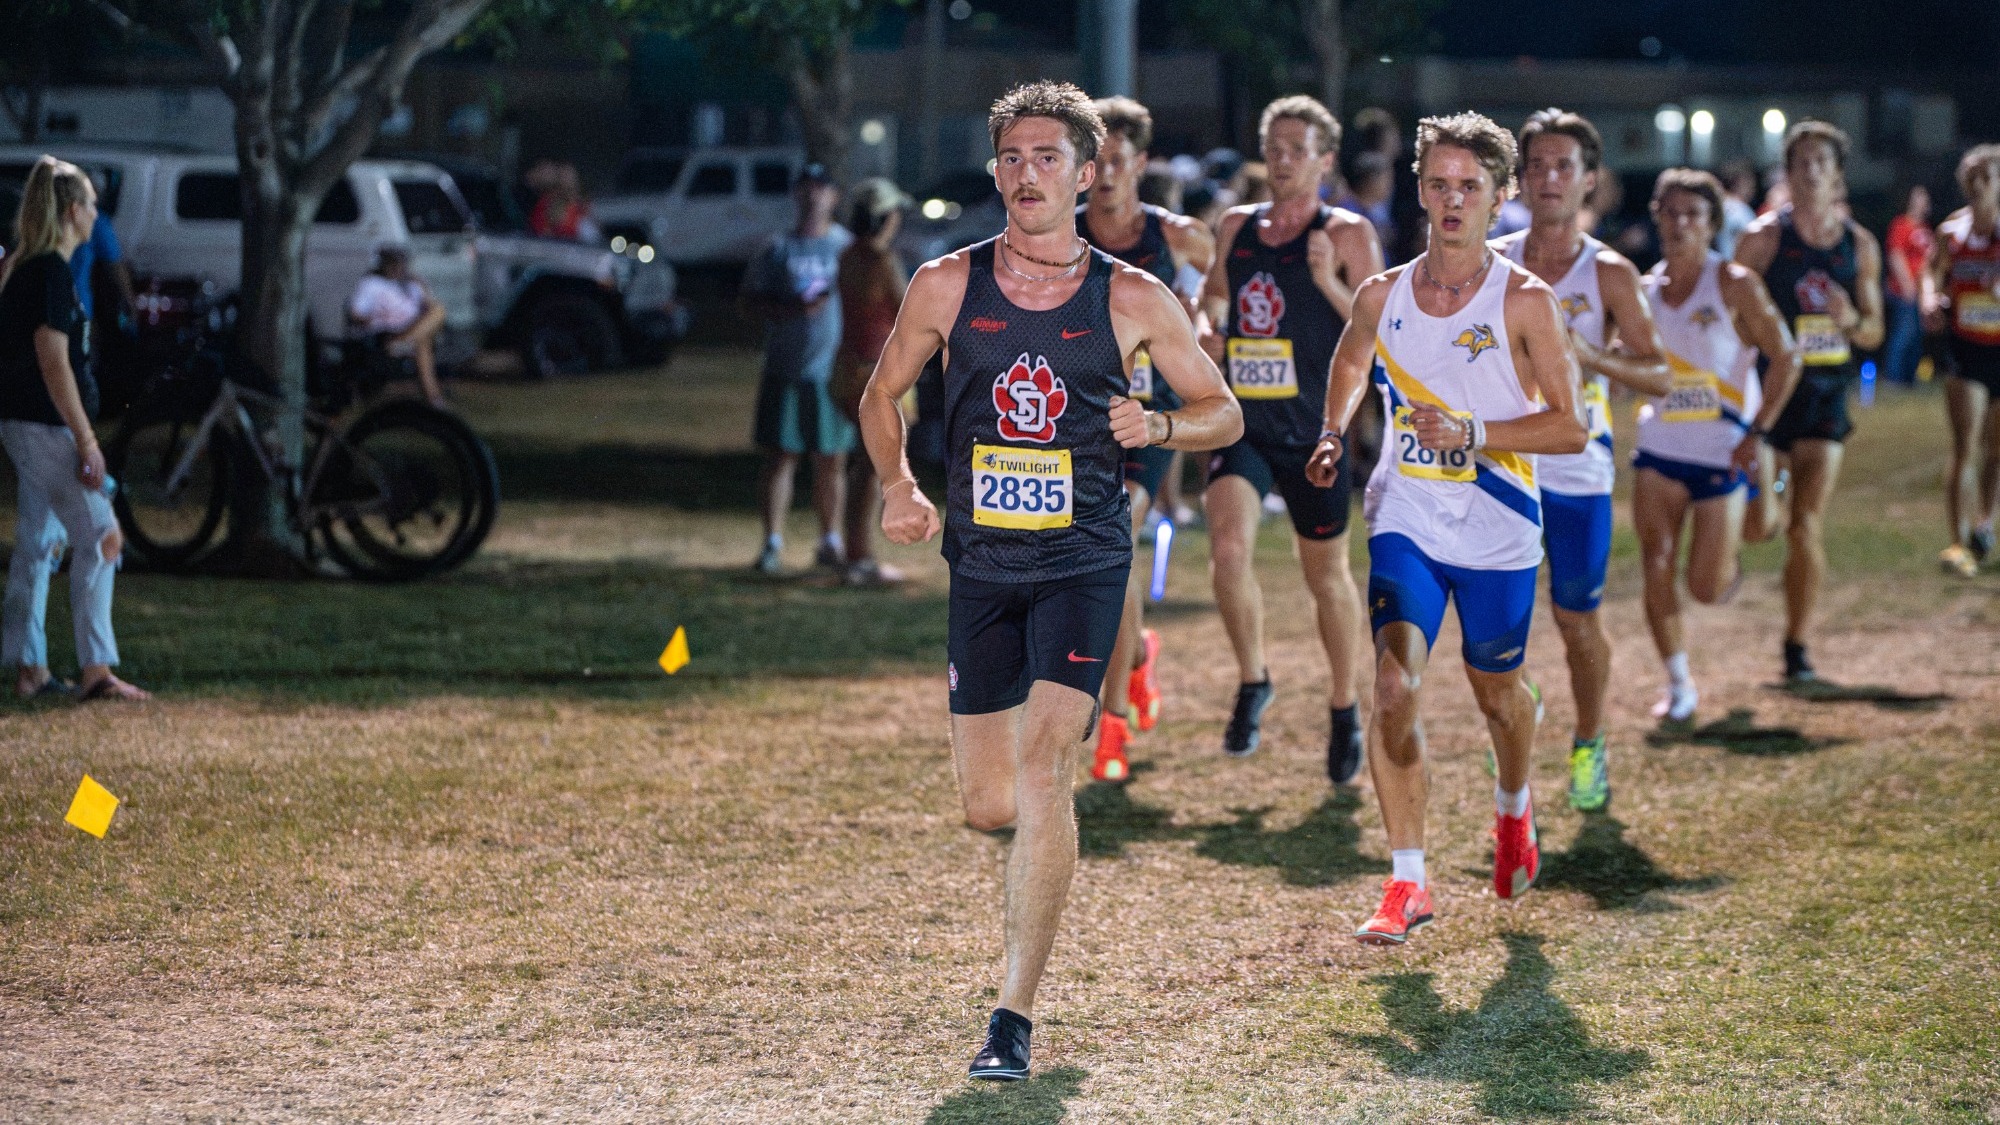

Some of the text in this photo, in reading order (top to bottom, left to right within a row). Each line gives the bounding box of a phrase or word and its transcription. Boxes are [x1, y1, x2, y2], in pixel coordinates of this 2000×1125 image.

[1235, 359, 1287, 385] 2837
[998, 459, 1060, 474] TWILIGHT
[980, 474, 1066, 513] 2835
